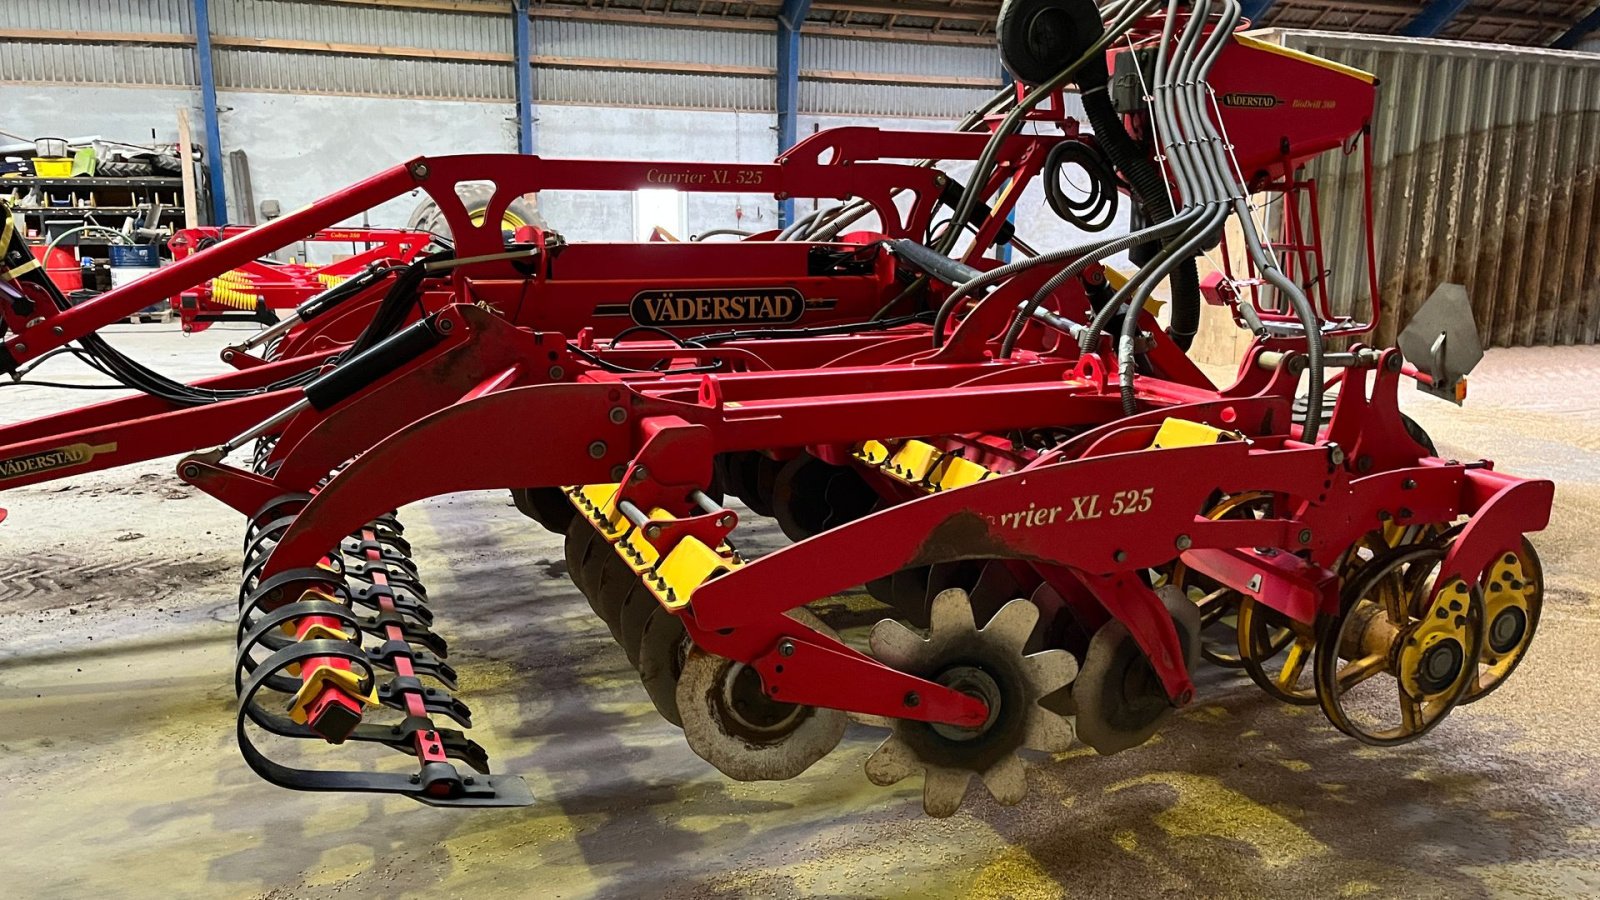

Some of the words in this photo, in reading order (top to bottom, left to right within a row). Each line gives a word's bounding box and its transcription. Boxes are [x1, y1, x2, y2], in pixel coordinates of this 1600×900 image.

[1226, 94, 1274, 107] VÄDERSTAD
[646, 168, 706, 183] Carrier
[711, 170, 731, 184] XL
[736, 170, 763, 184] 525
[642, 292, 794, 322] VÄDERSTAD
[0, 449, 83, 477] VÄDERSTAD
[978, 502, 1062, 530] rrier
[1066, 494, 1102, 522] XL
[1109, 487, 1154, 516] 525
